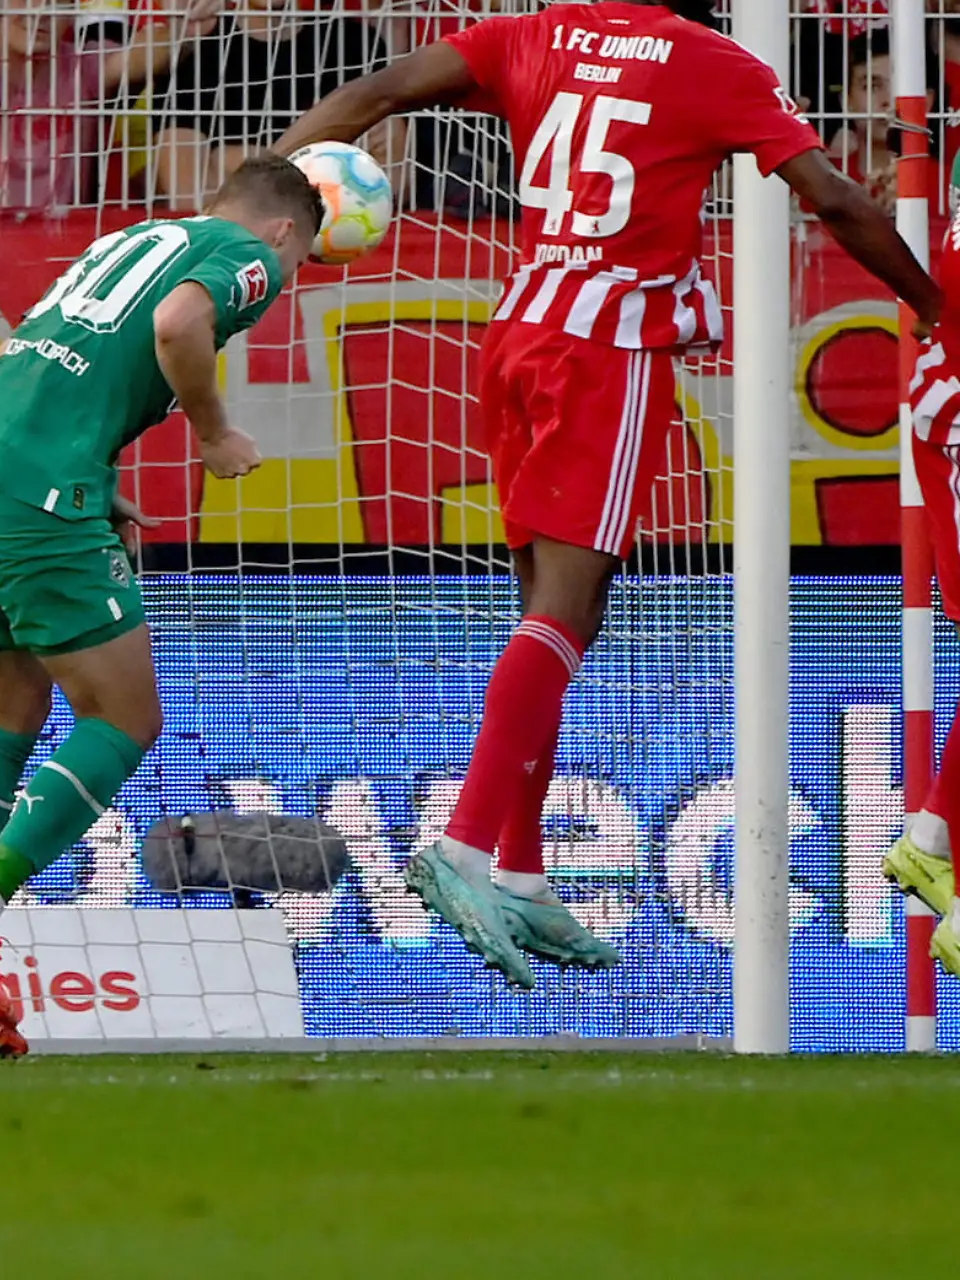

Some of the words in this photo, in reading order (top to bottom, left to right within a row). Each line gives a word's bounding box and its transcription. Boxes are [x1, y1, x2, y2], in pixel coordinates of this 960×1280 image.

[599, 35, 674, 64] UNION
[573, 61, 623, 83] BERLIN
[519, 91, 653, 238] 45
